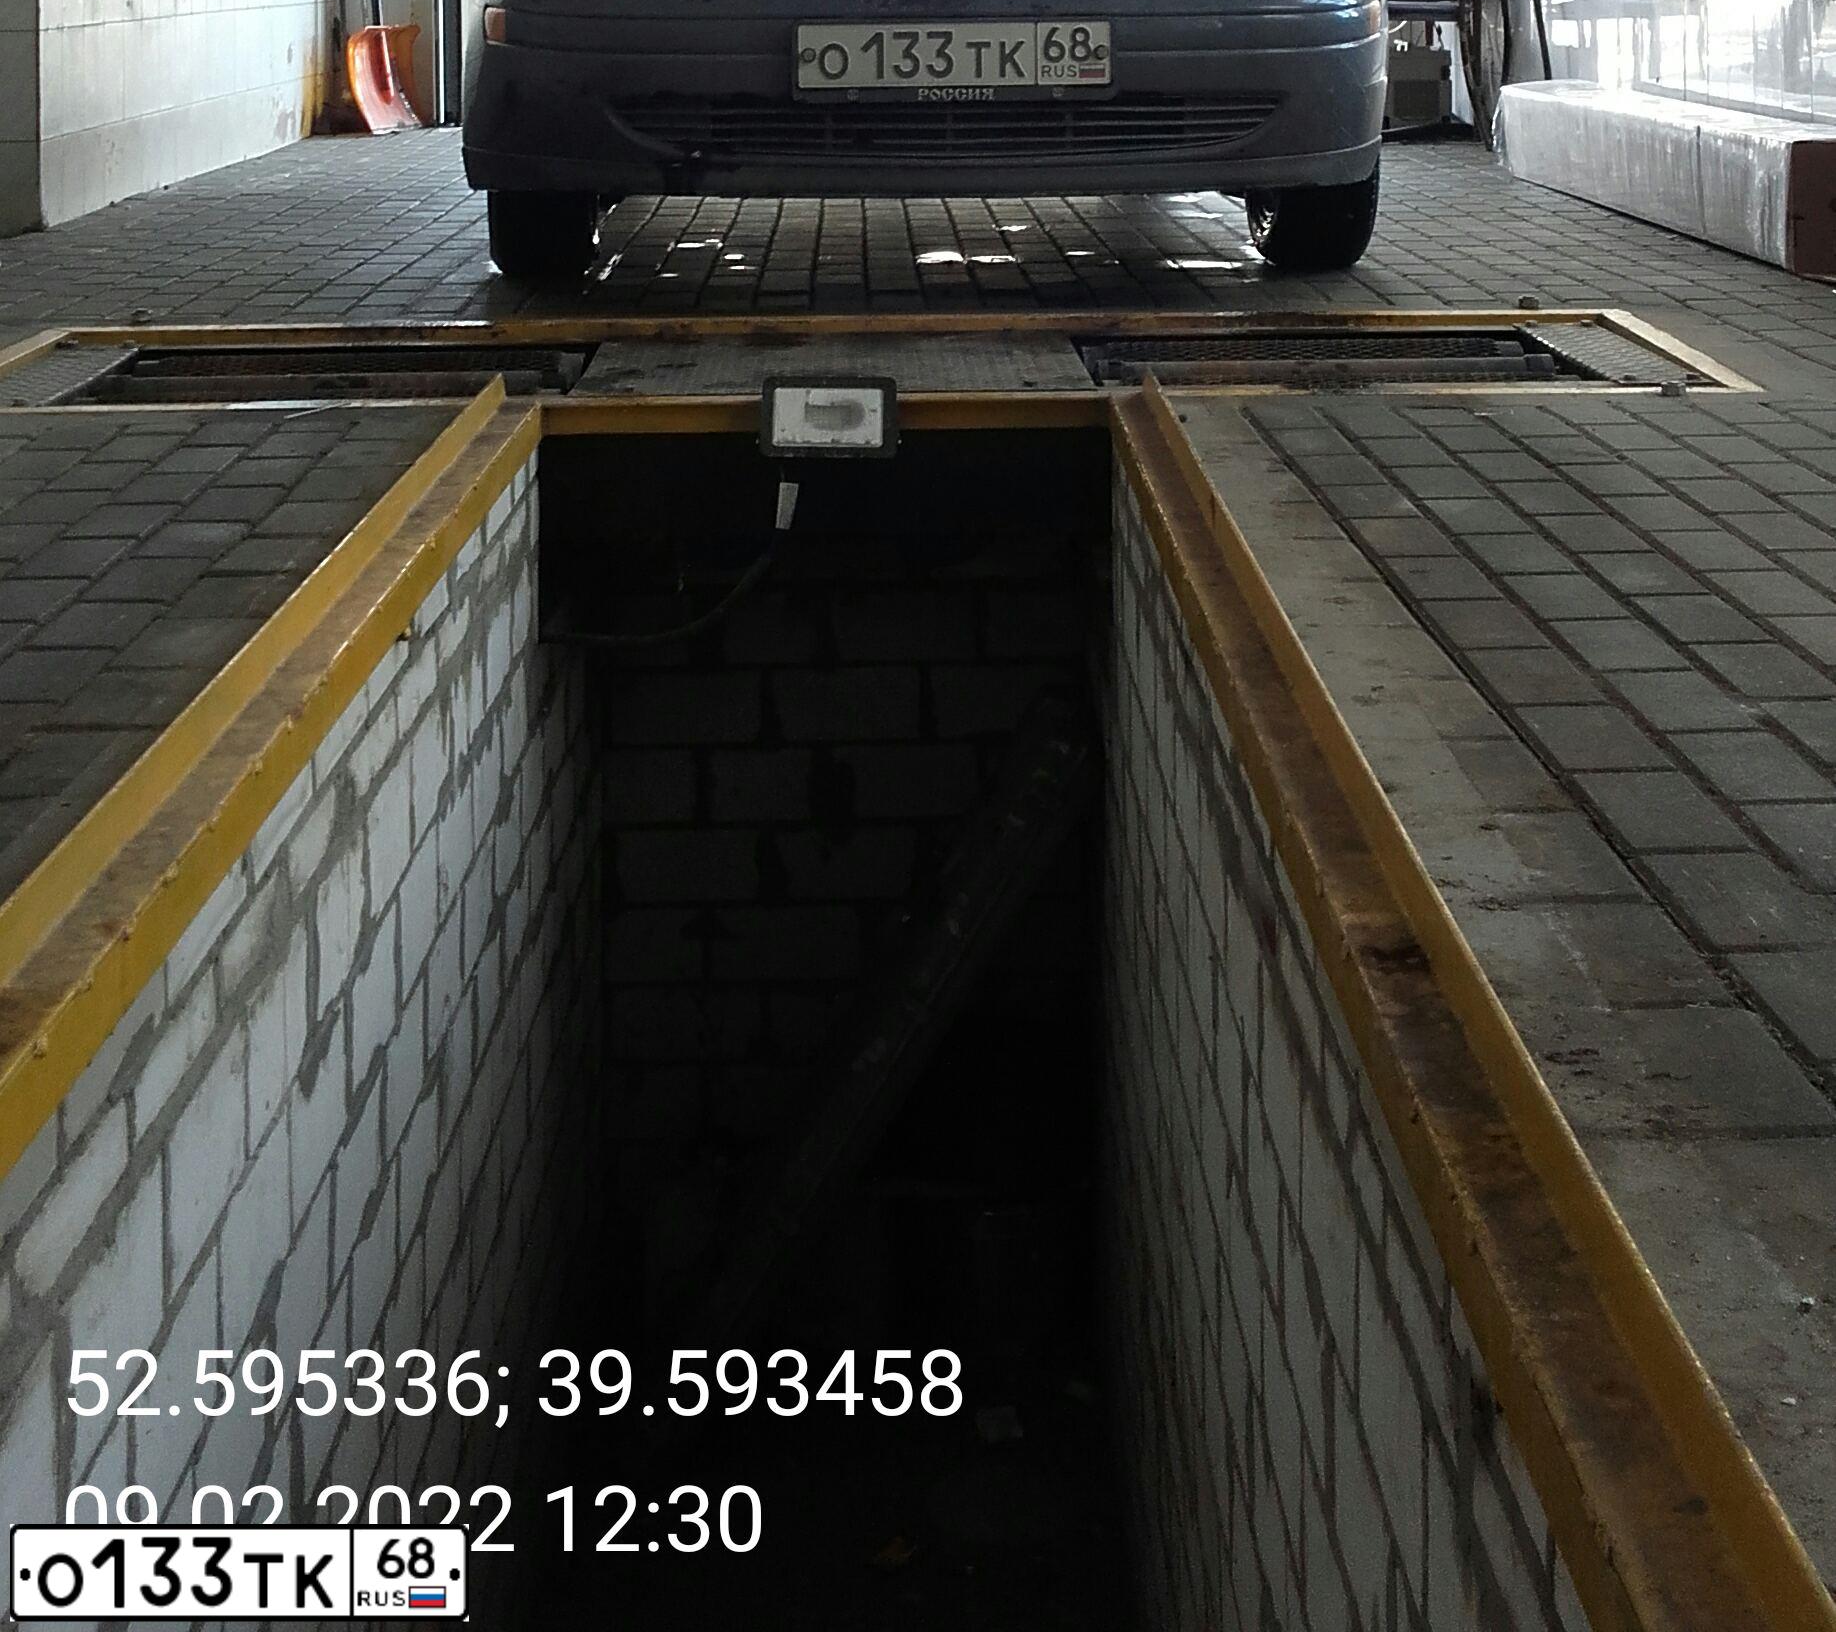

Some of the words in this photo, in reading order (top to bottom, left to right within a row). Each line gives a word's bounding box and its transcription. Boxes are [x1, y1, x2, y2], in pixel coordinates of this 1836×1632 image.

[1043, 26, 1092, 63] 68
[1041, 65, 1077, 78] RUS
[918, 88, 995, 101] РОССИЯ
